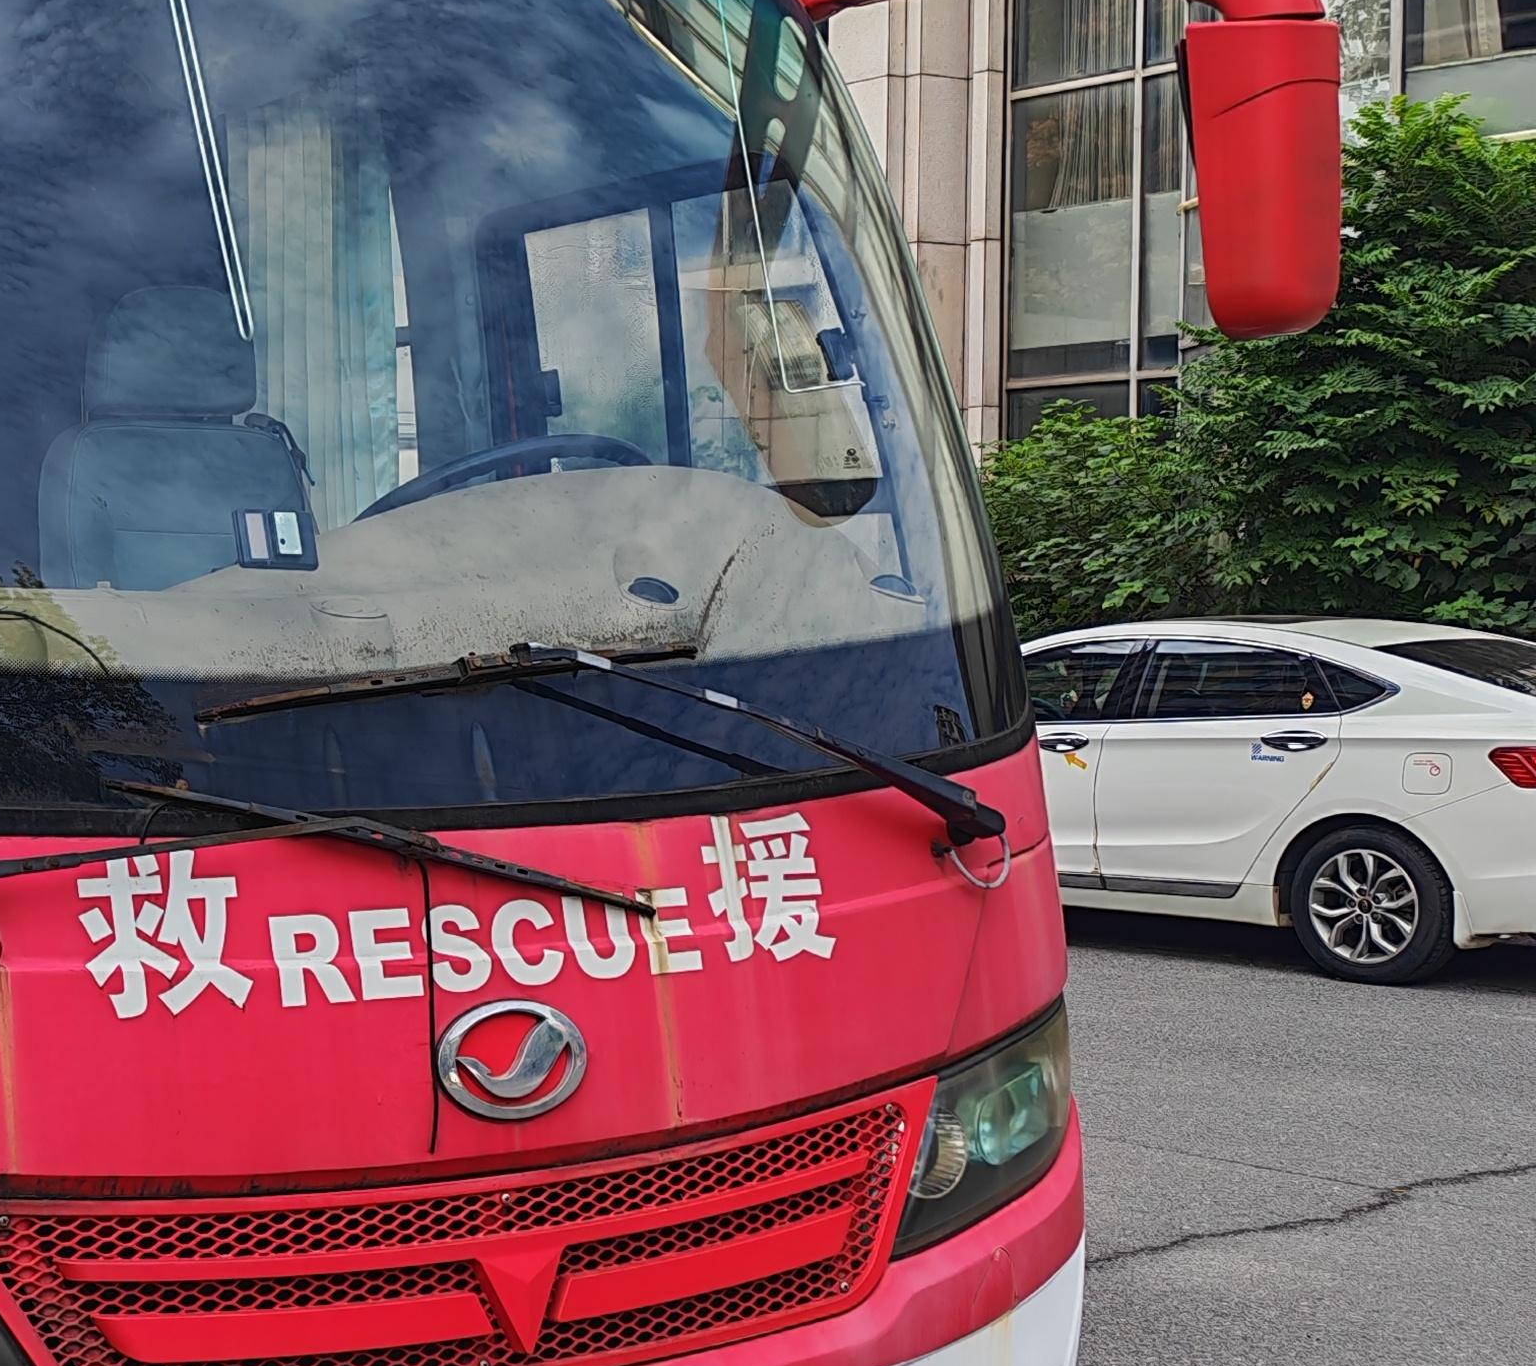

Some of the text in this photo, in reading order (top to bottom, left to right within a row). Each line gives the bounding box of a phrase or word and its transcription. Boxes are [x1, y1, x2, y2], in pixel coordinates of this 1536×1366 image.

[77, 812, 836, 1019] 救 RESCUE 援
